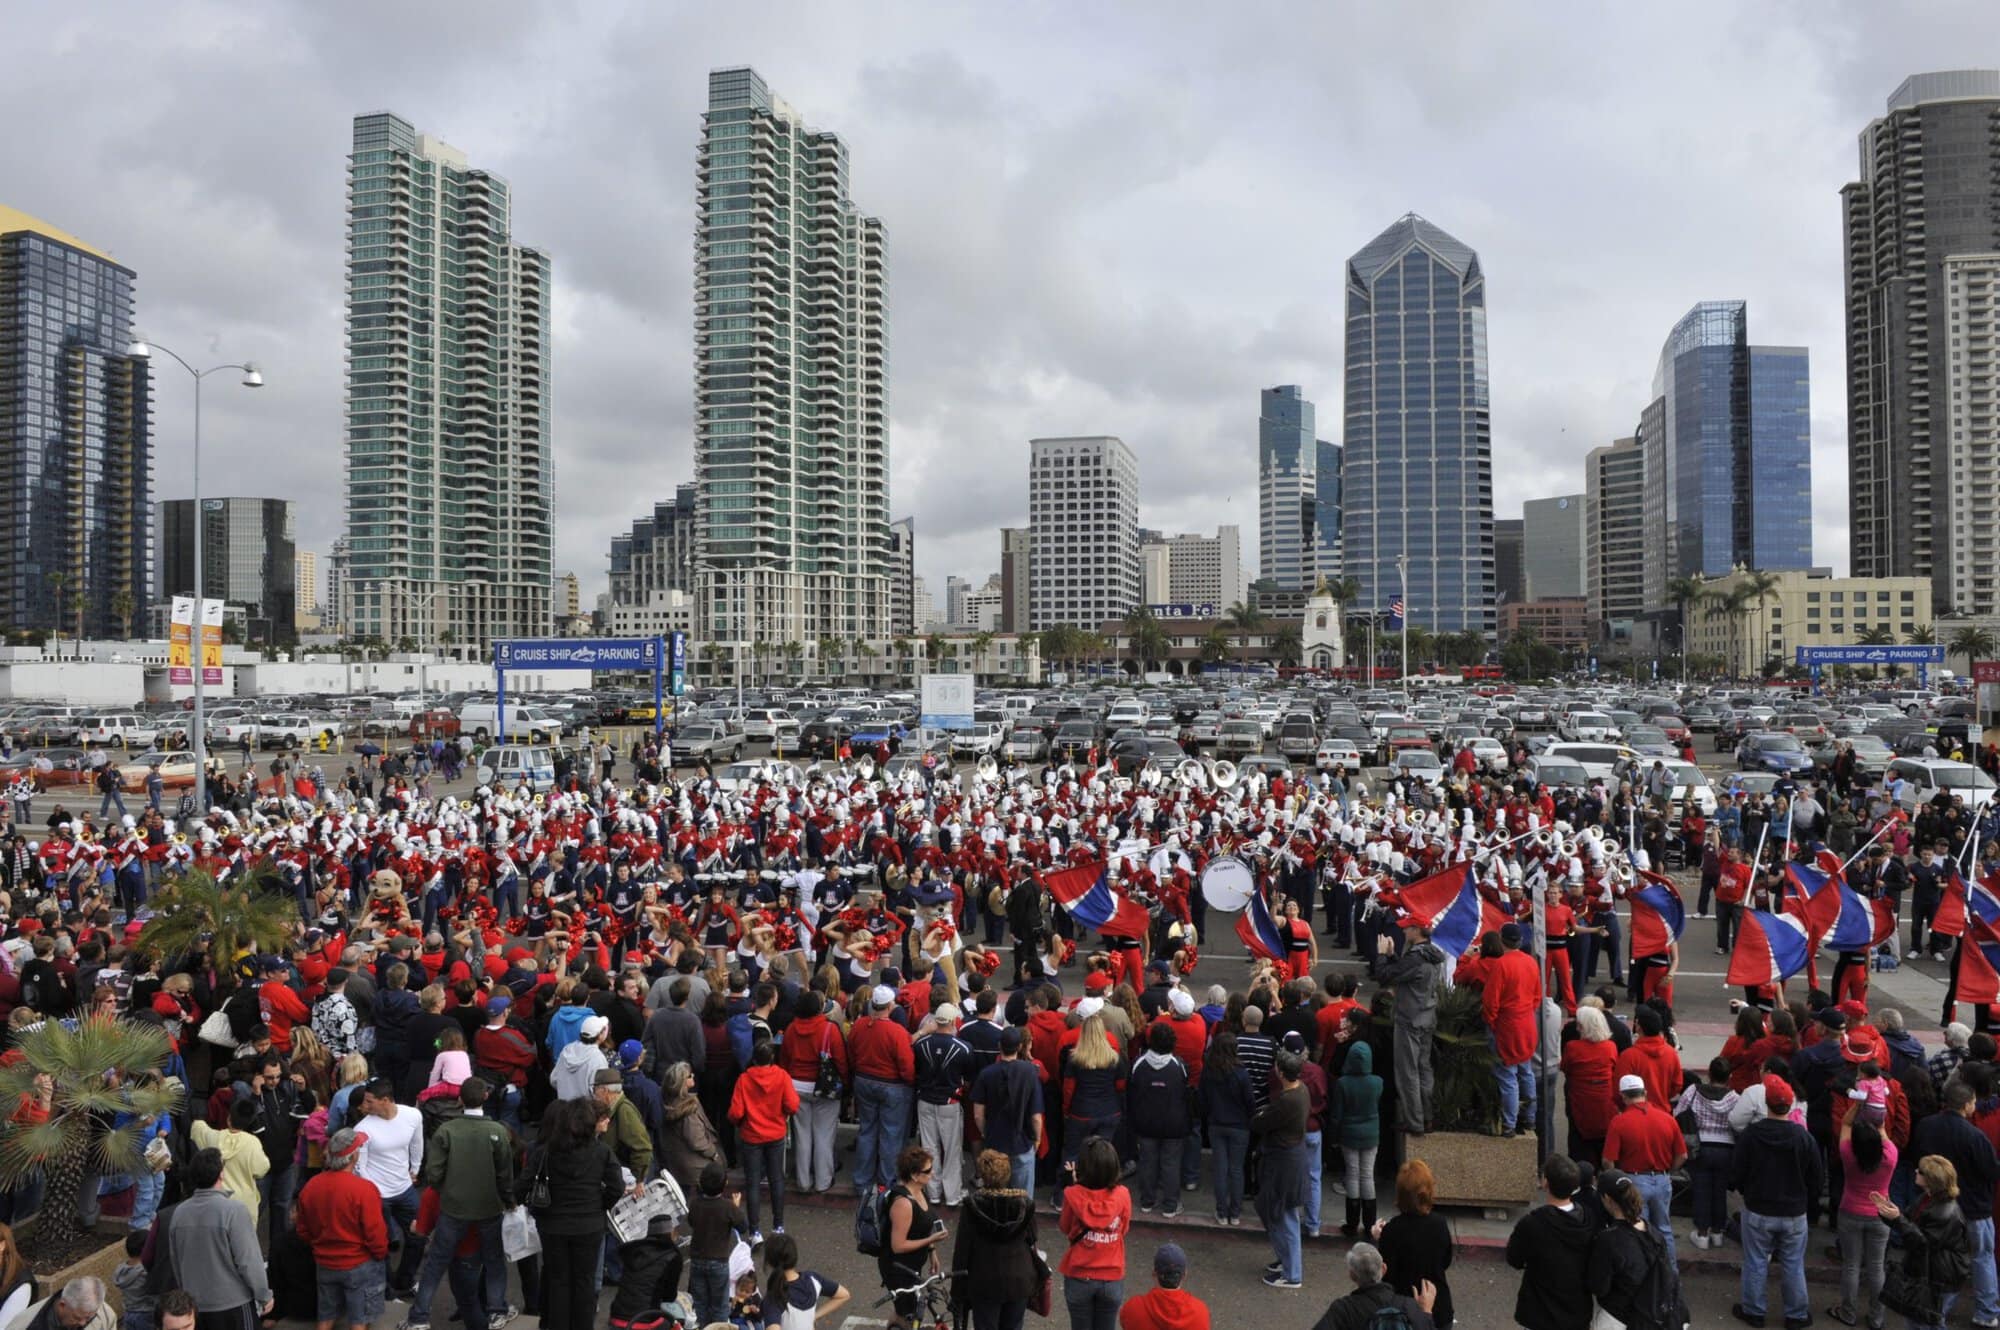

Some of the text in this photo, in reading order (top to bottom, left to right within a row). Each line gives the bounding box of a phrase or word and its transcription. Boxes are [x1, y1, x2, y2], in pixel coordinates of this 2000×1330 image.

[1192, 604, 1210, 616] Fe
[501, 645, 509, 657] 5
[645, 643, 653, 656] 5
[675, 634, 682, 656] 5
[514, 648, 640, 660] CRUISE SHIP PARKING
[1890, 650, 1928, 658] PARKING
[675, 674, 682, 690] P
